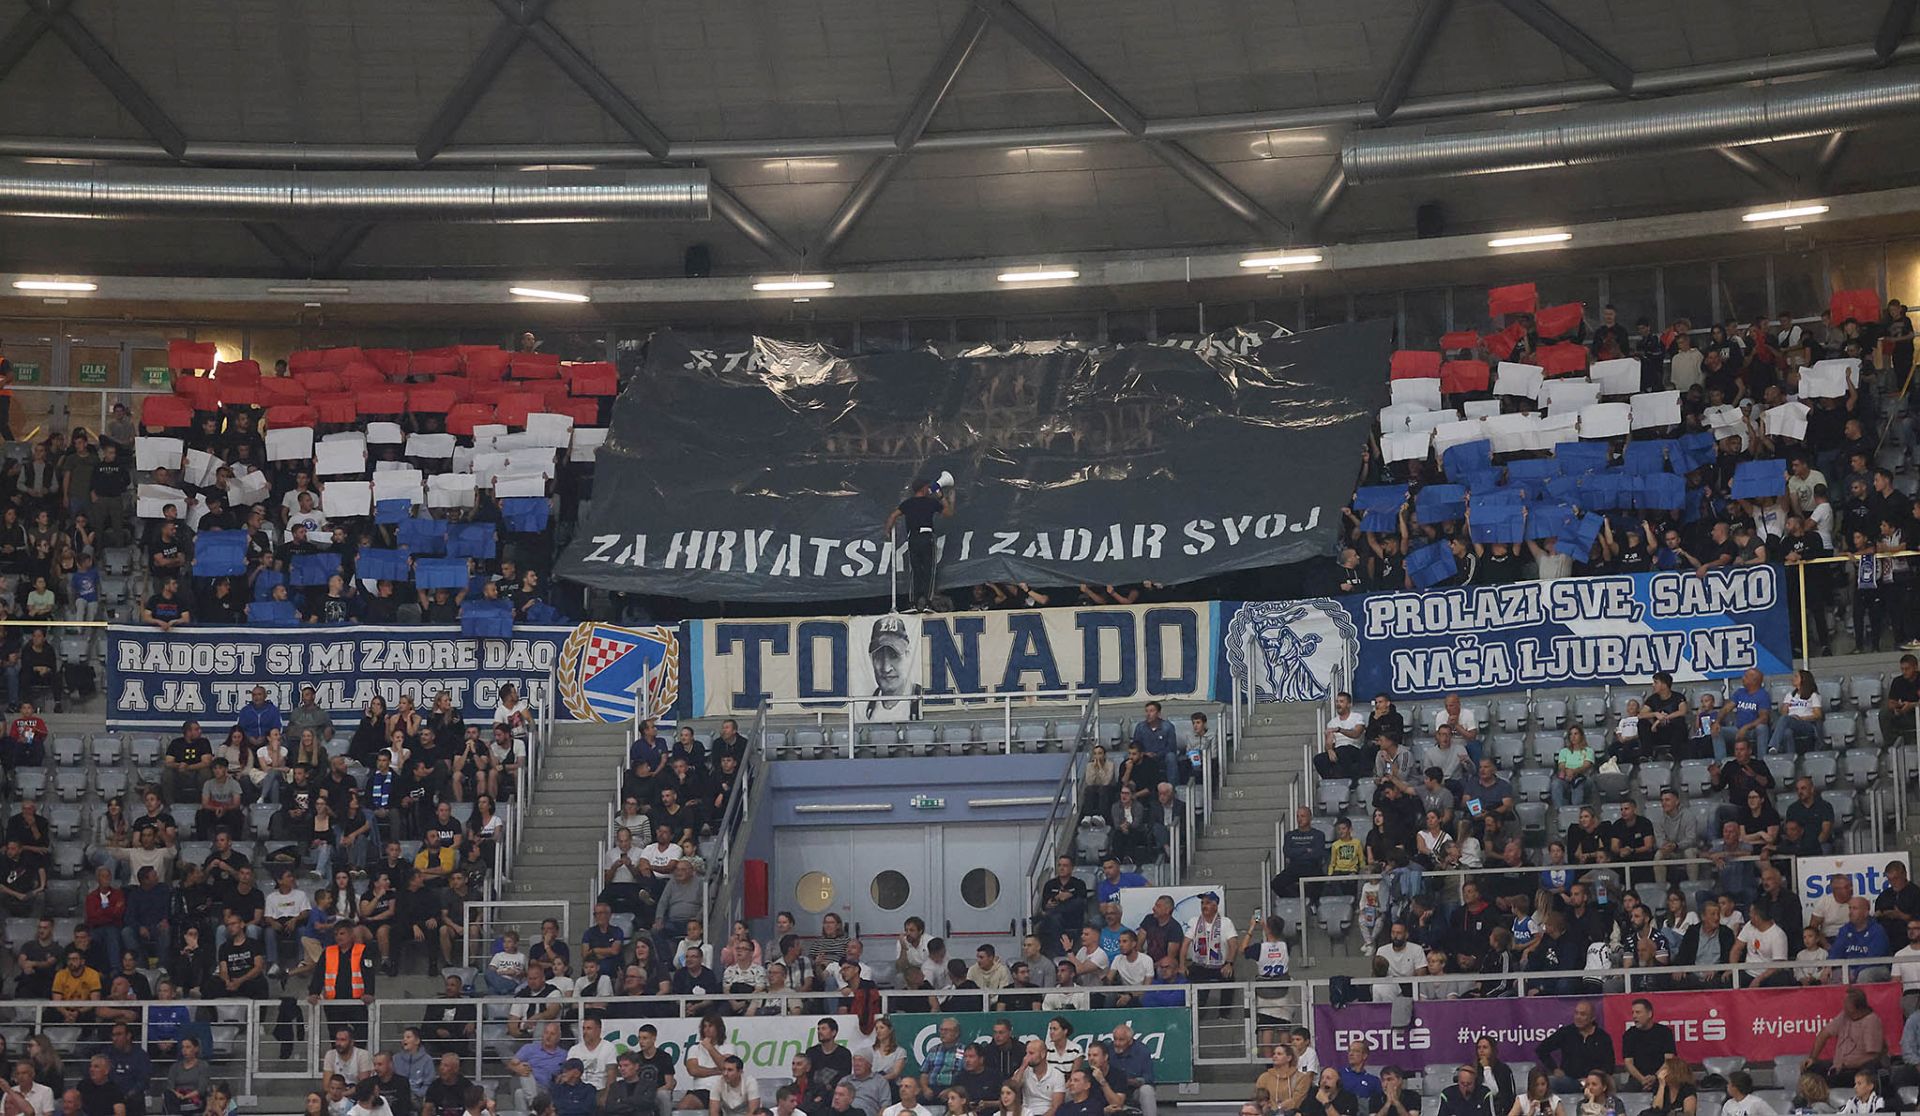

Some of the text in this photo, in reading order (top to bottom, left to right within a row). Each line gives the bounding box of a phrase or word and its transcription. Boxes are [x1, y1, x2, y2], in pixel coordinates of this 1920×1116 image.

[583, 534, 647, 566] ZA
[988, 523, 1168, 563] ZADAR
[1182, 506, 1321, 555] SVOJ
[1364, 564, 1777, 638] PROLAZI SVE, SAMO
[118, 640, 556, 674] RADOST SI MI ZADRE DAO
[716, 608, 1198, 710] TONADO
[1391, 624, 1756, 693] NAŠA LJUBAV NE
[118, 680, 148, 711] A
[153, 681, 206, 712] JA
[299, 678, 469, 712] MLADOST
[731, 1028, 849, 1067] ban
